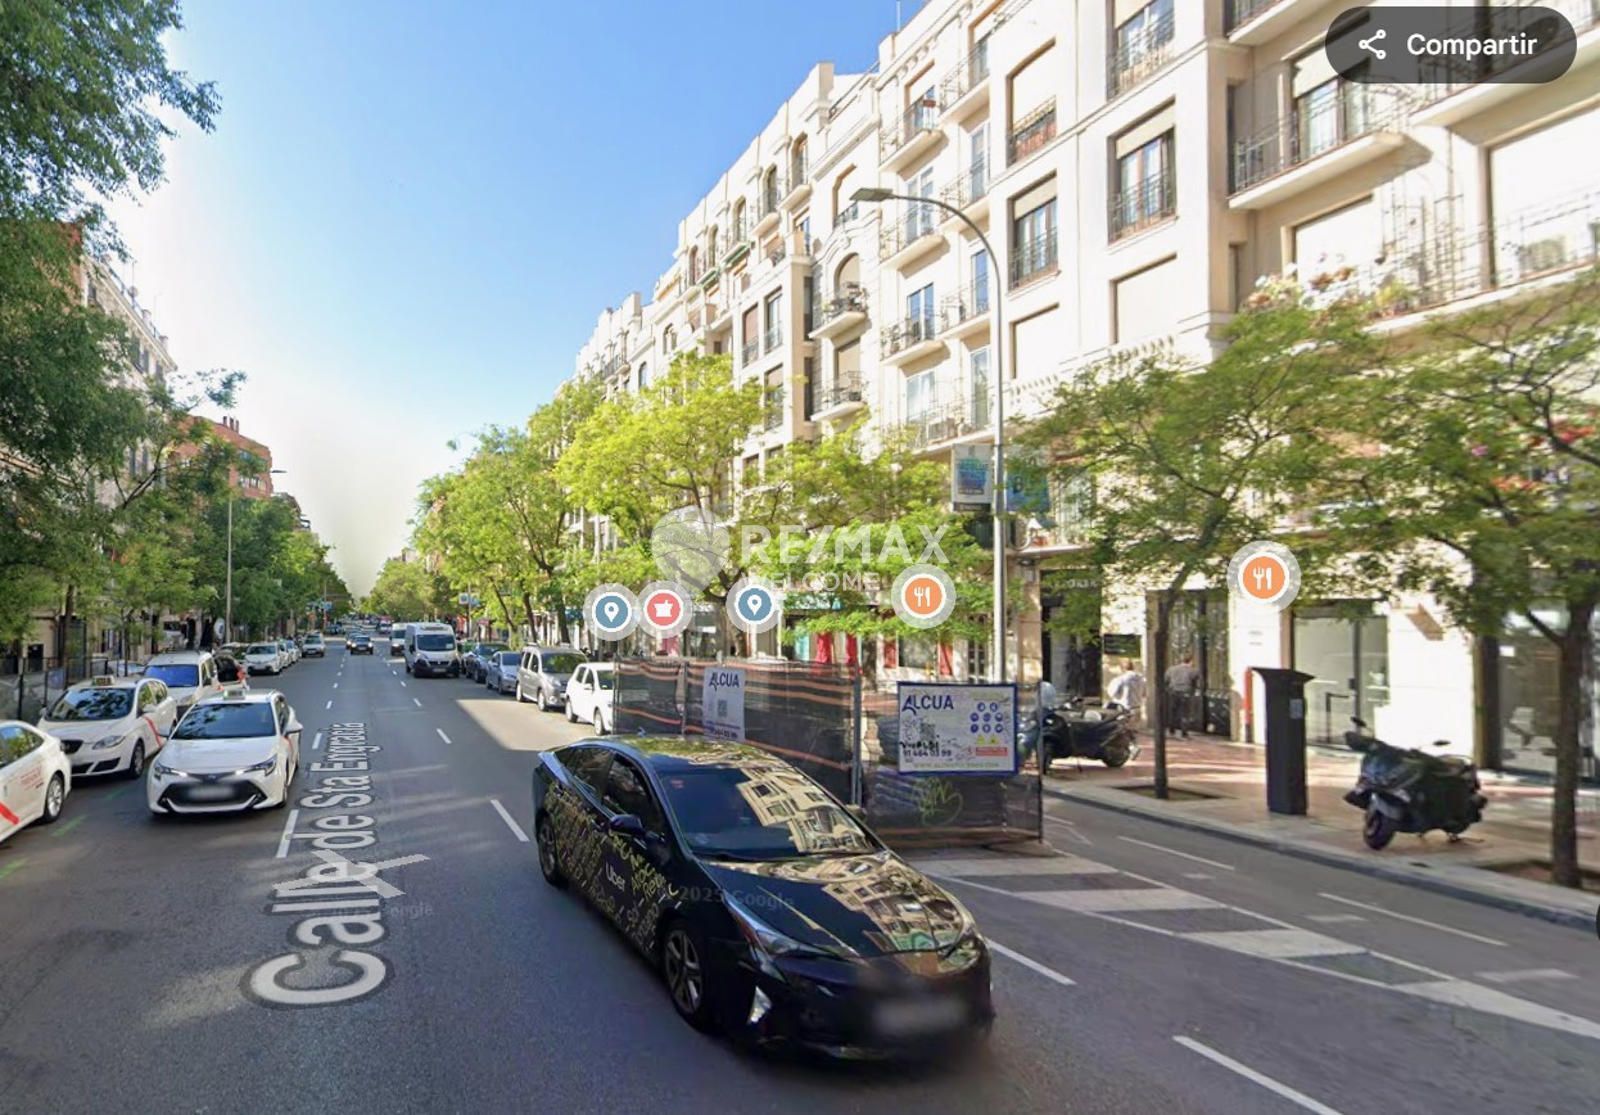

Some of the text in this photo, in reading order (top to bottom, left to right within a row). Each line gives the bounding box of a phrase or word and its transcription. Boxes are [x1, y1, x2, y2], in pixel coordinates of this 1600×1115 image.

[709, 672, 739, 691] ALCUA
[901, 695, 954, 715] ALCUA
[605, 860, 626, 893] Uber
